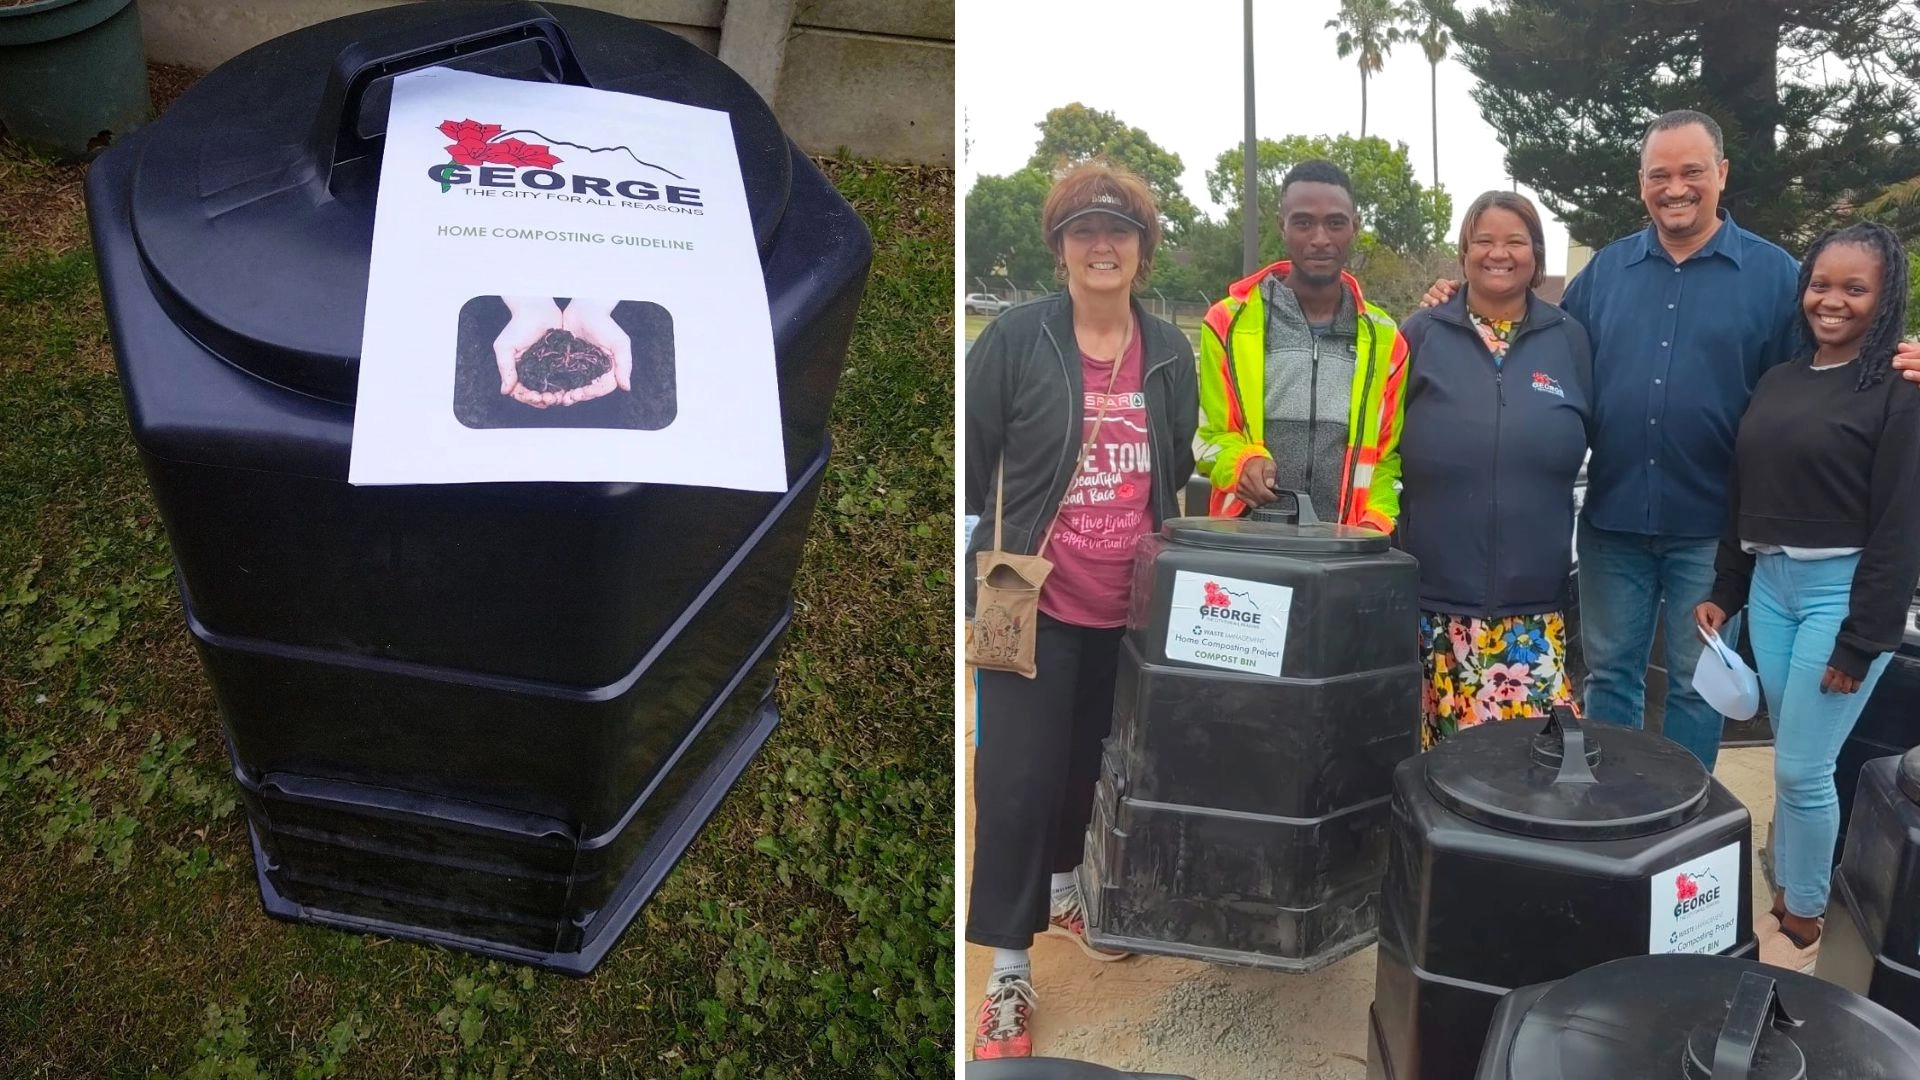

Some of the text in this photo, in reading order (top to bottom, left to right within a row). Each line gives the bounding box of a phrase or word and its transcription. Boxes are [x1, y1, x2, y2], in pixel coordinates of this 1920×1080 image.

[427, 163, 704, 207] GEORGE
[463, 188, 704, 215] THE CITY FOR ALL REASONS
[438, 225, 694, 251] HOME COMPOSTING GUIDELINE
[1085, 395, 1129, 407] SPAR
[1059, 488, 1116, 506] oad Race
[1199, 605, 1262, 624] GEORGE
[1203, 629, 1224, 638] WASTE
[1175, 634, 1279, 658] Home Composting Project
[1194, 650, 1257, 668] COMPOST BIN
[1674, 886, 1720, 918] GEORGE
[1677, 928, 1714, 952] Composting
[1707, 939, 1720, 953] BIN
